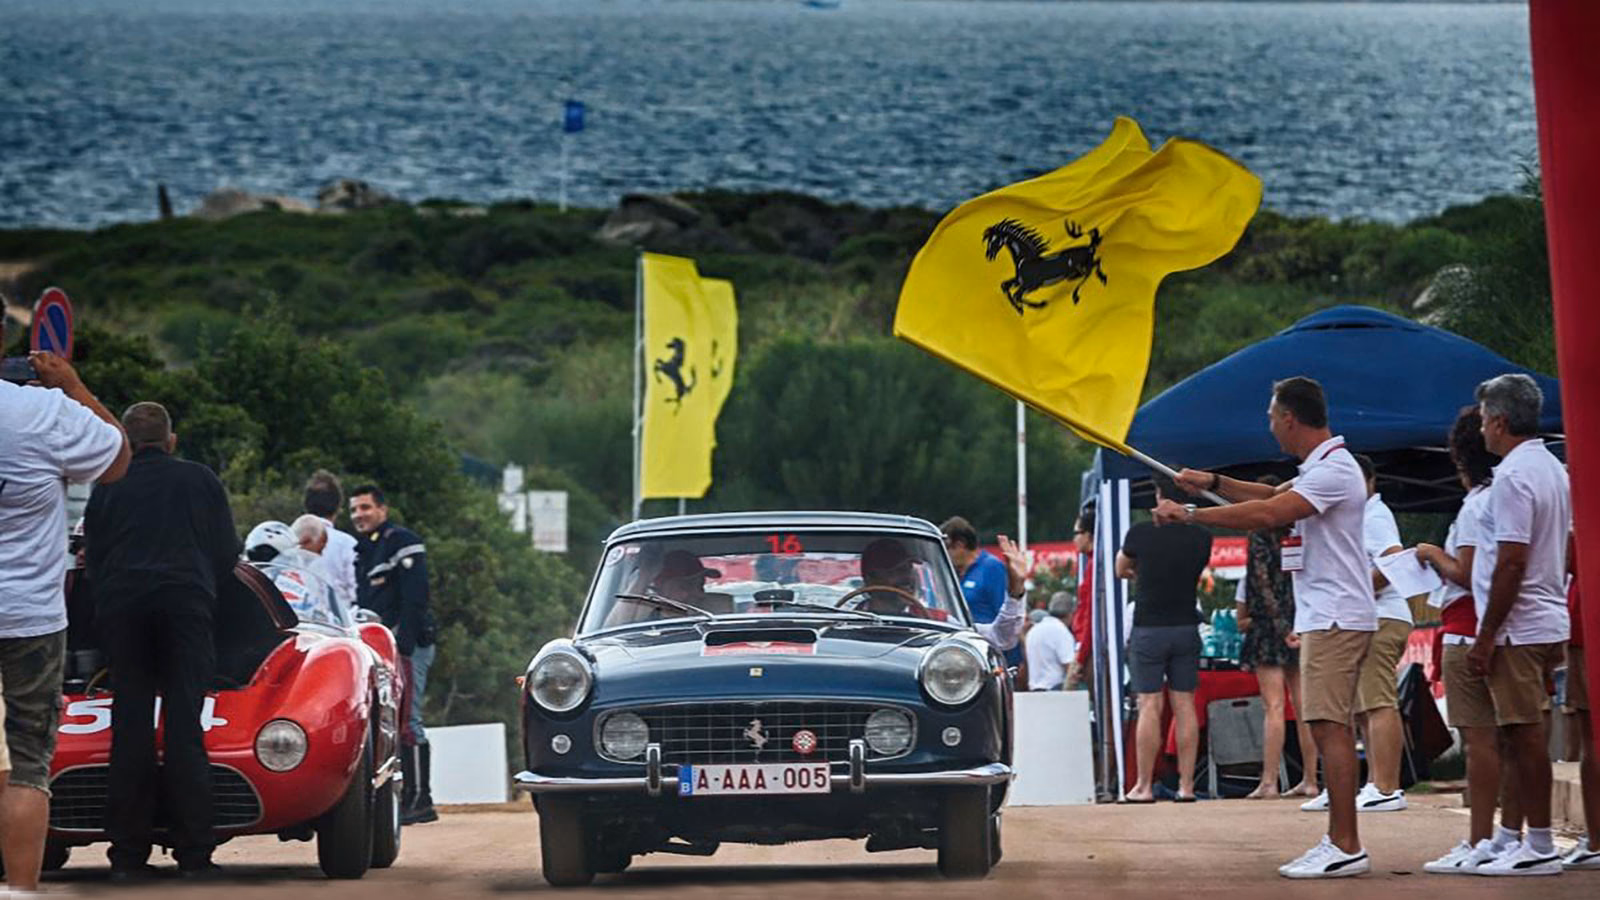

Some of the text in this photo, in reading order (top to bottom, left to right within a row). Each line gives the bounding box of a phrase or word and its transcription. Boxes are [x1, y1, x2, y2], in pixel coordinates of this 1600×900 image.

[767, 535, 802, 555] 16
[681, 782, 691, 793] B
[697, 767, 827, 790] A-AAA-005
